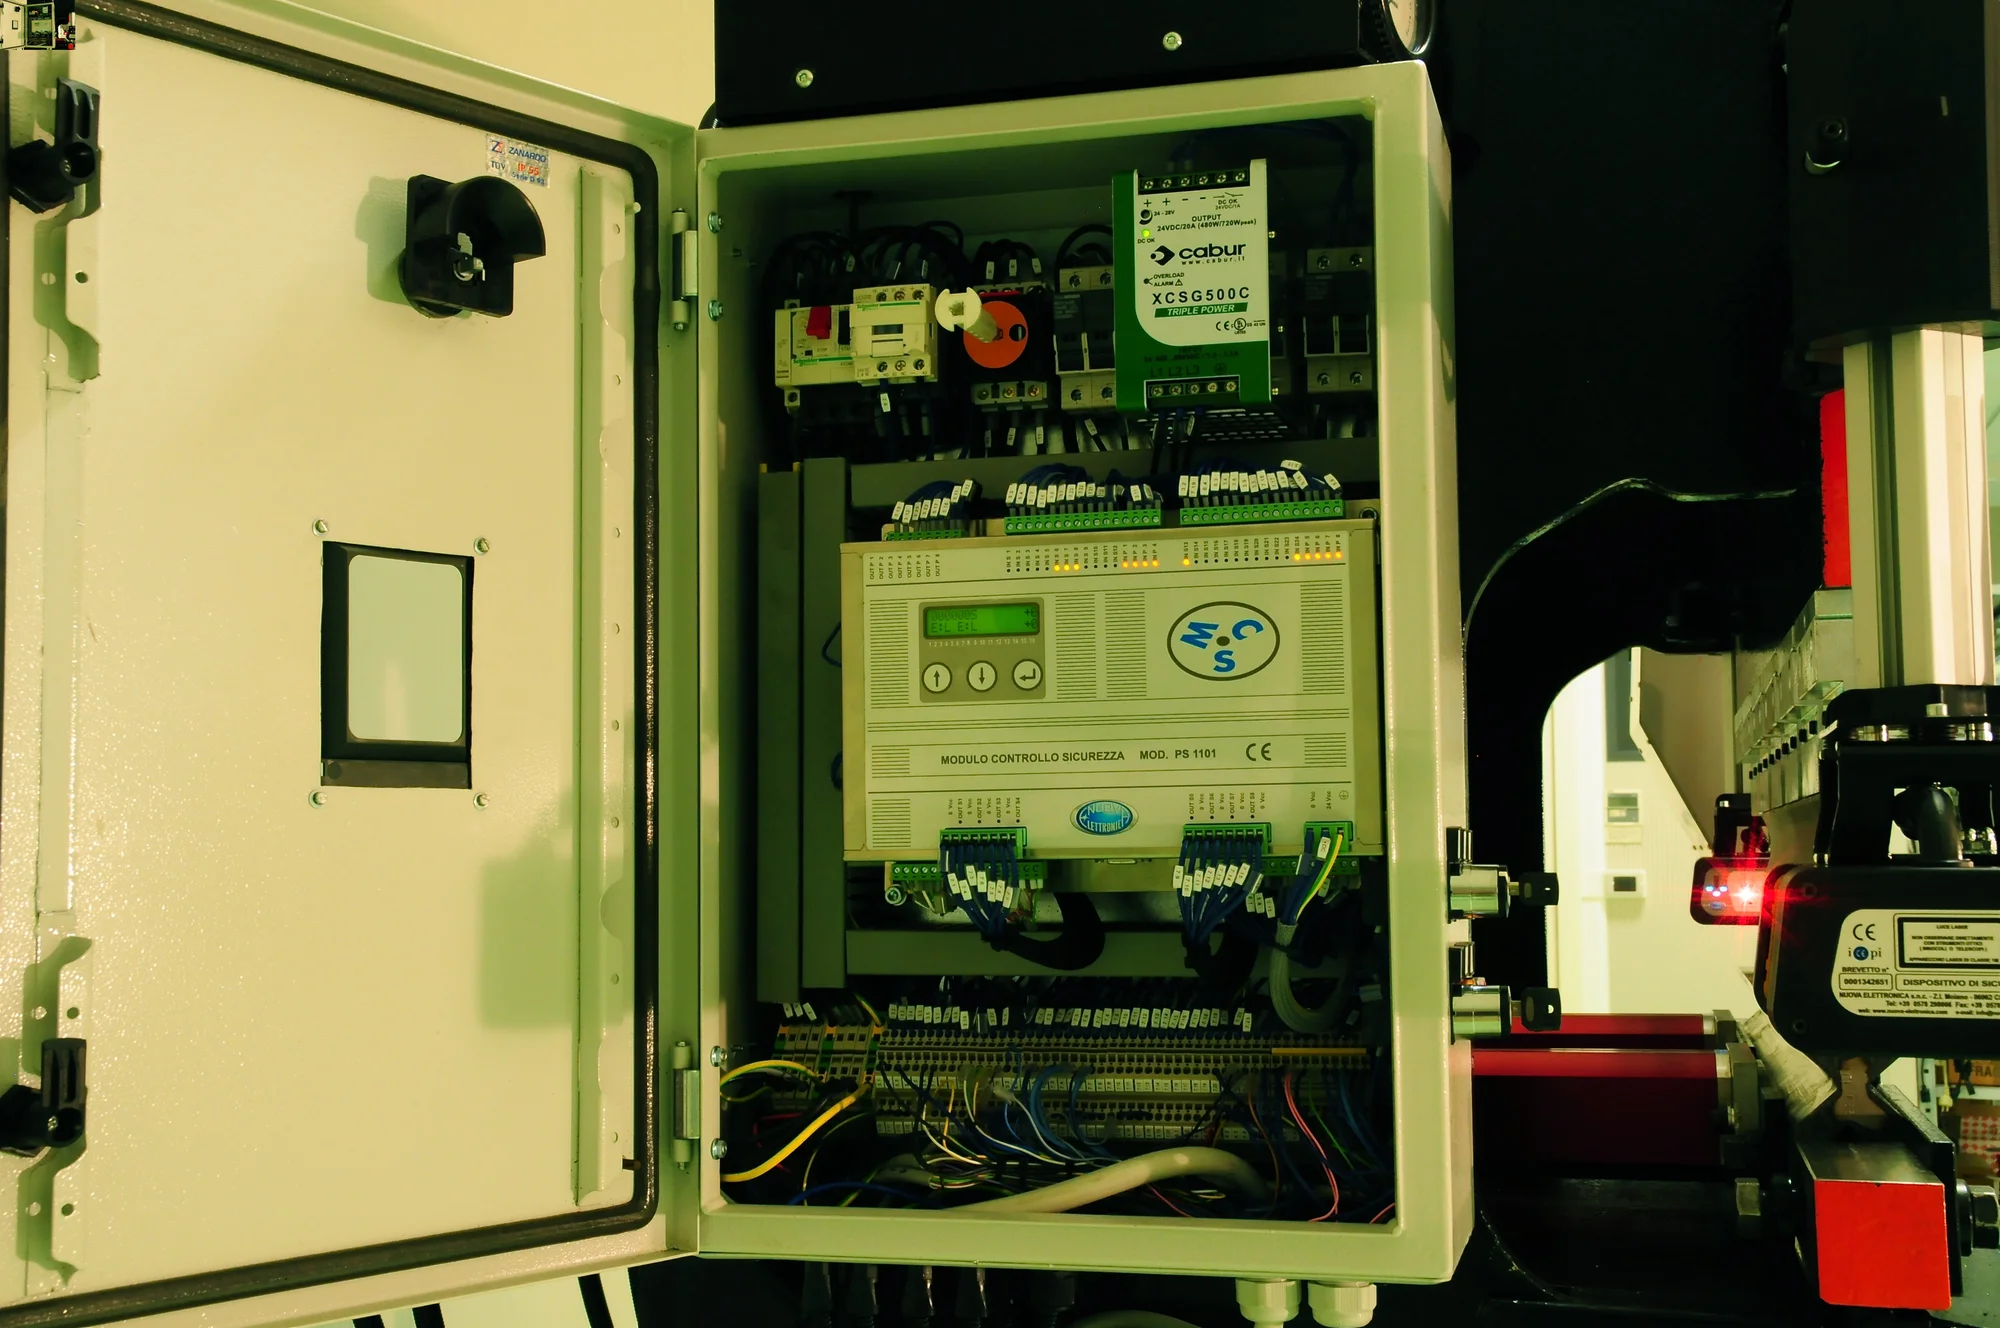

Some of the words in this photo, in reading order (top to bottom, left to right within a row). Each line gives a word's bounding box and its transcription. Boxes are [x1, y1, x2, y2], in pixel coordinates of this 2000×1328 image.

[509, 147, 547, 163] ZANARDO
[517, 163, 526, 172] IP
[1191, 214, 1222, 222] OUTPUT
[1157, 223, 1196, 232] 24VDC/20A
[1179, 243, 1246, 260] cabur
[1152, 287, 1250, 305] XCSG500C
[1167, 306, 1199, 316] TRIPLE
[1201, 304, 1235, 314] POWER
[1150, 366, 1163, 378] L1
[1168, 366, 1182, 377] L2
[1186, 365, 1200, 375] L3
[941, 754, 989, 765] MODULO
[991, 752, 1059, 764] CONTROLLO
[1062, 750, 1125, 762] SICUREZZA
[1139, 749, 1169, 760] MOD.
[1174, 748, 1190, 760] PS
[1193, 748, 1216, 759] 1101
[1853, 923, 1876, 941] CE
[1903, 978, 1966, 986] DISPOSITIVO
